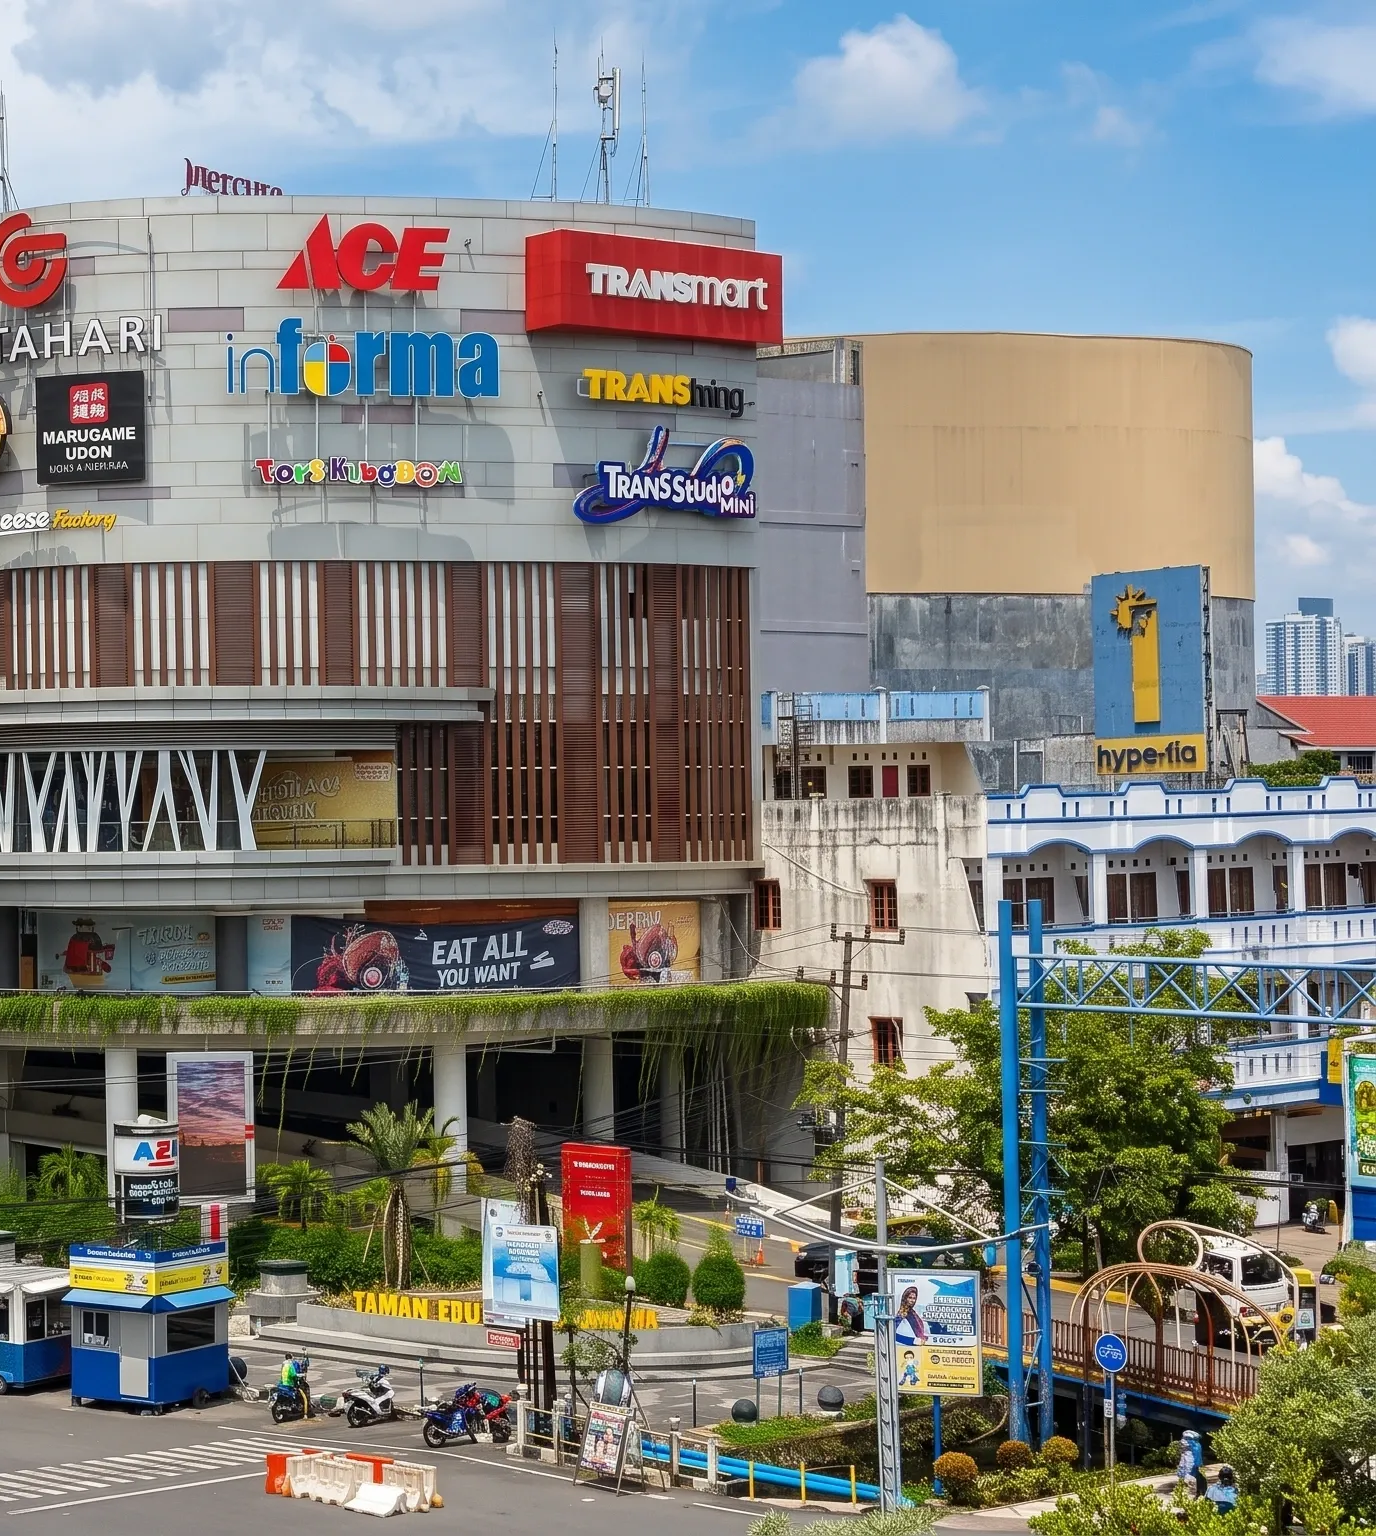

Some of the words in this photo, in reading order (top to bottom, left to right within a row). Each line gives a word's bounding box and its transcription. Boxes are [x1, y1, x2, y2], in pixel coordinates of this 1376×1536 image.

[276, 213, 451, 291] ACE
[585, 262, 769, 311] TRANSmart
[226, 316, 500, 398] informa
[43, 427, 136, 445] MARUGAME
[65, 445, 112, 460] UDON
[432, 937, 477, 965] EAT
[482, 931, 528, 961] ALL
[437, 967, 469, 987] YOU
[474, 961, 521, 985] WANT
[353, 1291, 429, 1320] TAMAN
